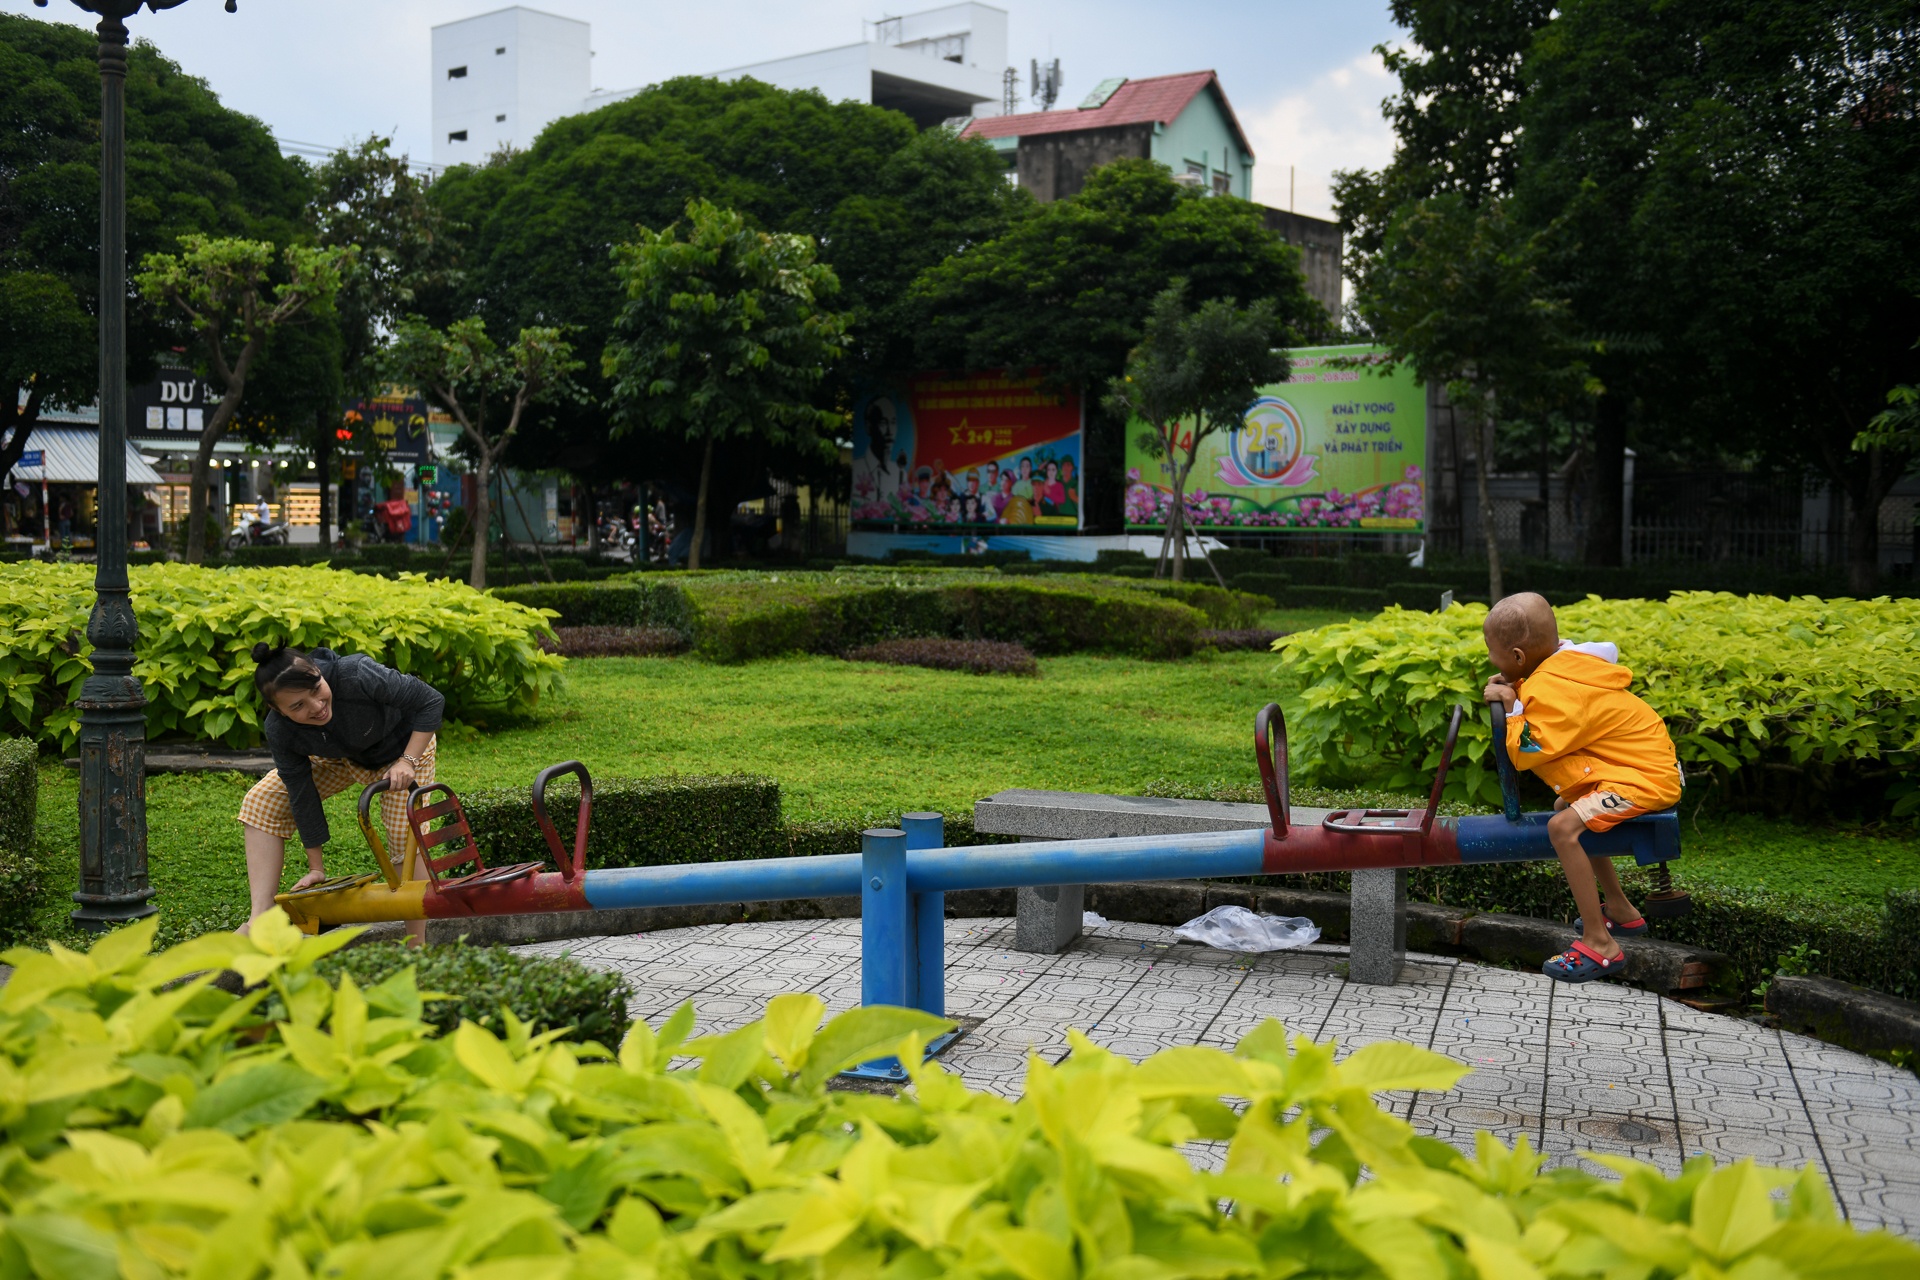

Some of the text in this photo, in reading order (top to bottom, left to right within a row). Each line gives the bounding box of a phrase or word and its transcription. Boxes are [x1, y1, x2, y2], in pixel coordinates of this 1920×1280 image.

[160, 378, 197, 404] DƯ
[1332, 400, 1395, 416] KHÁT VỌNG
[1246, 421, 1284, 452] 25
[1336, 420, 1391, 436] XÂY DỰNG
[1324, 436, 1403, 453] VÀ PHÁT TRIỂN
